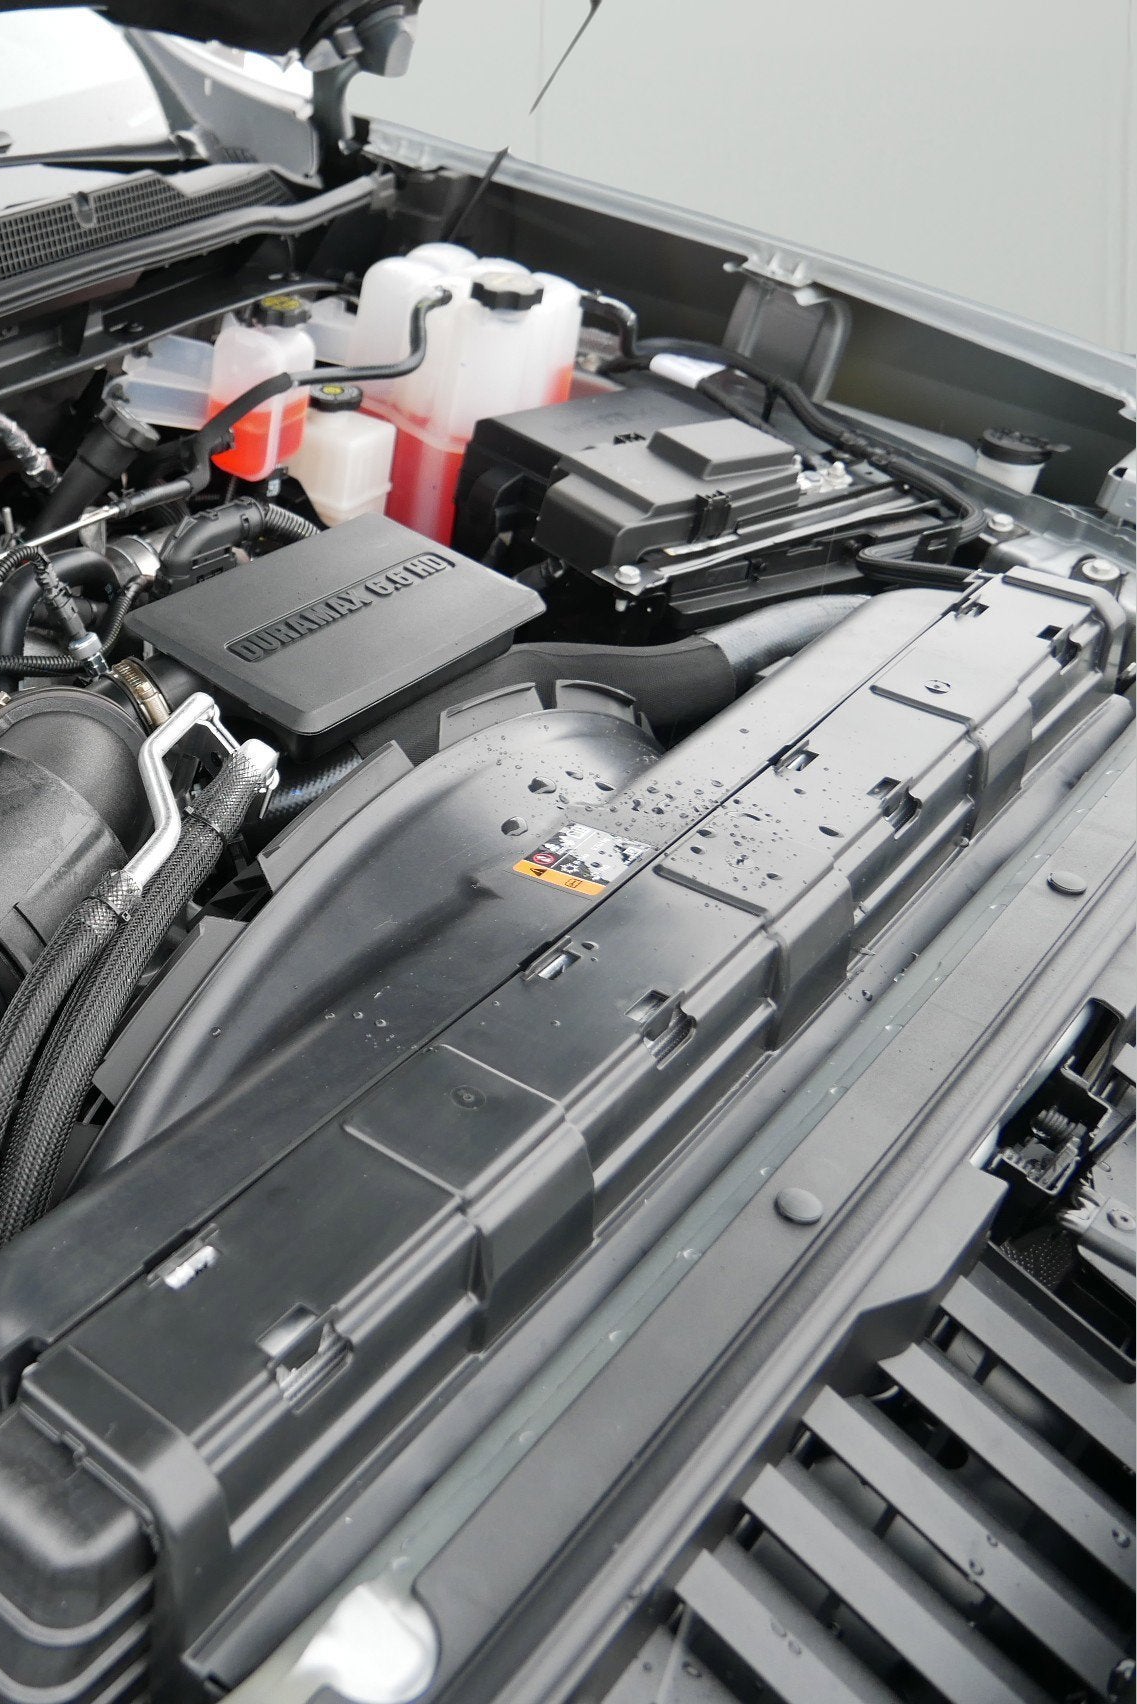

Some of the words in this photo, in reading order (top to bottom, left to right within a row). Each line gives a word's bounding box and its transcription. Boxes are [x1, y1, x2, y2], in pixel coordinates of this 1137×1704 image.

[227, 589, 373, 662] DURAMAX
[364, 567, 414, 597] 6.6
[403, 554, 448, 579] HD
